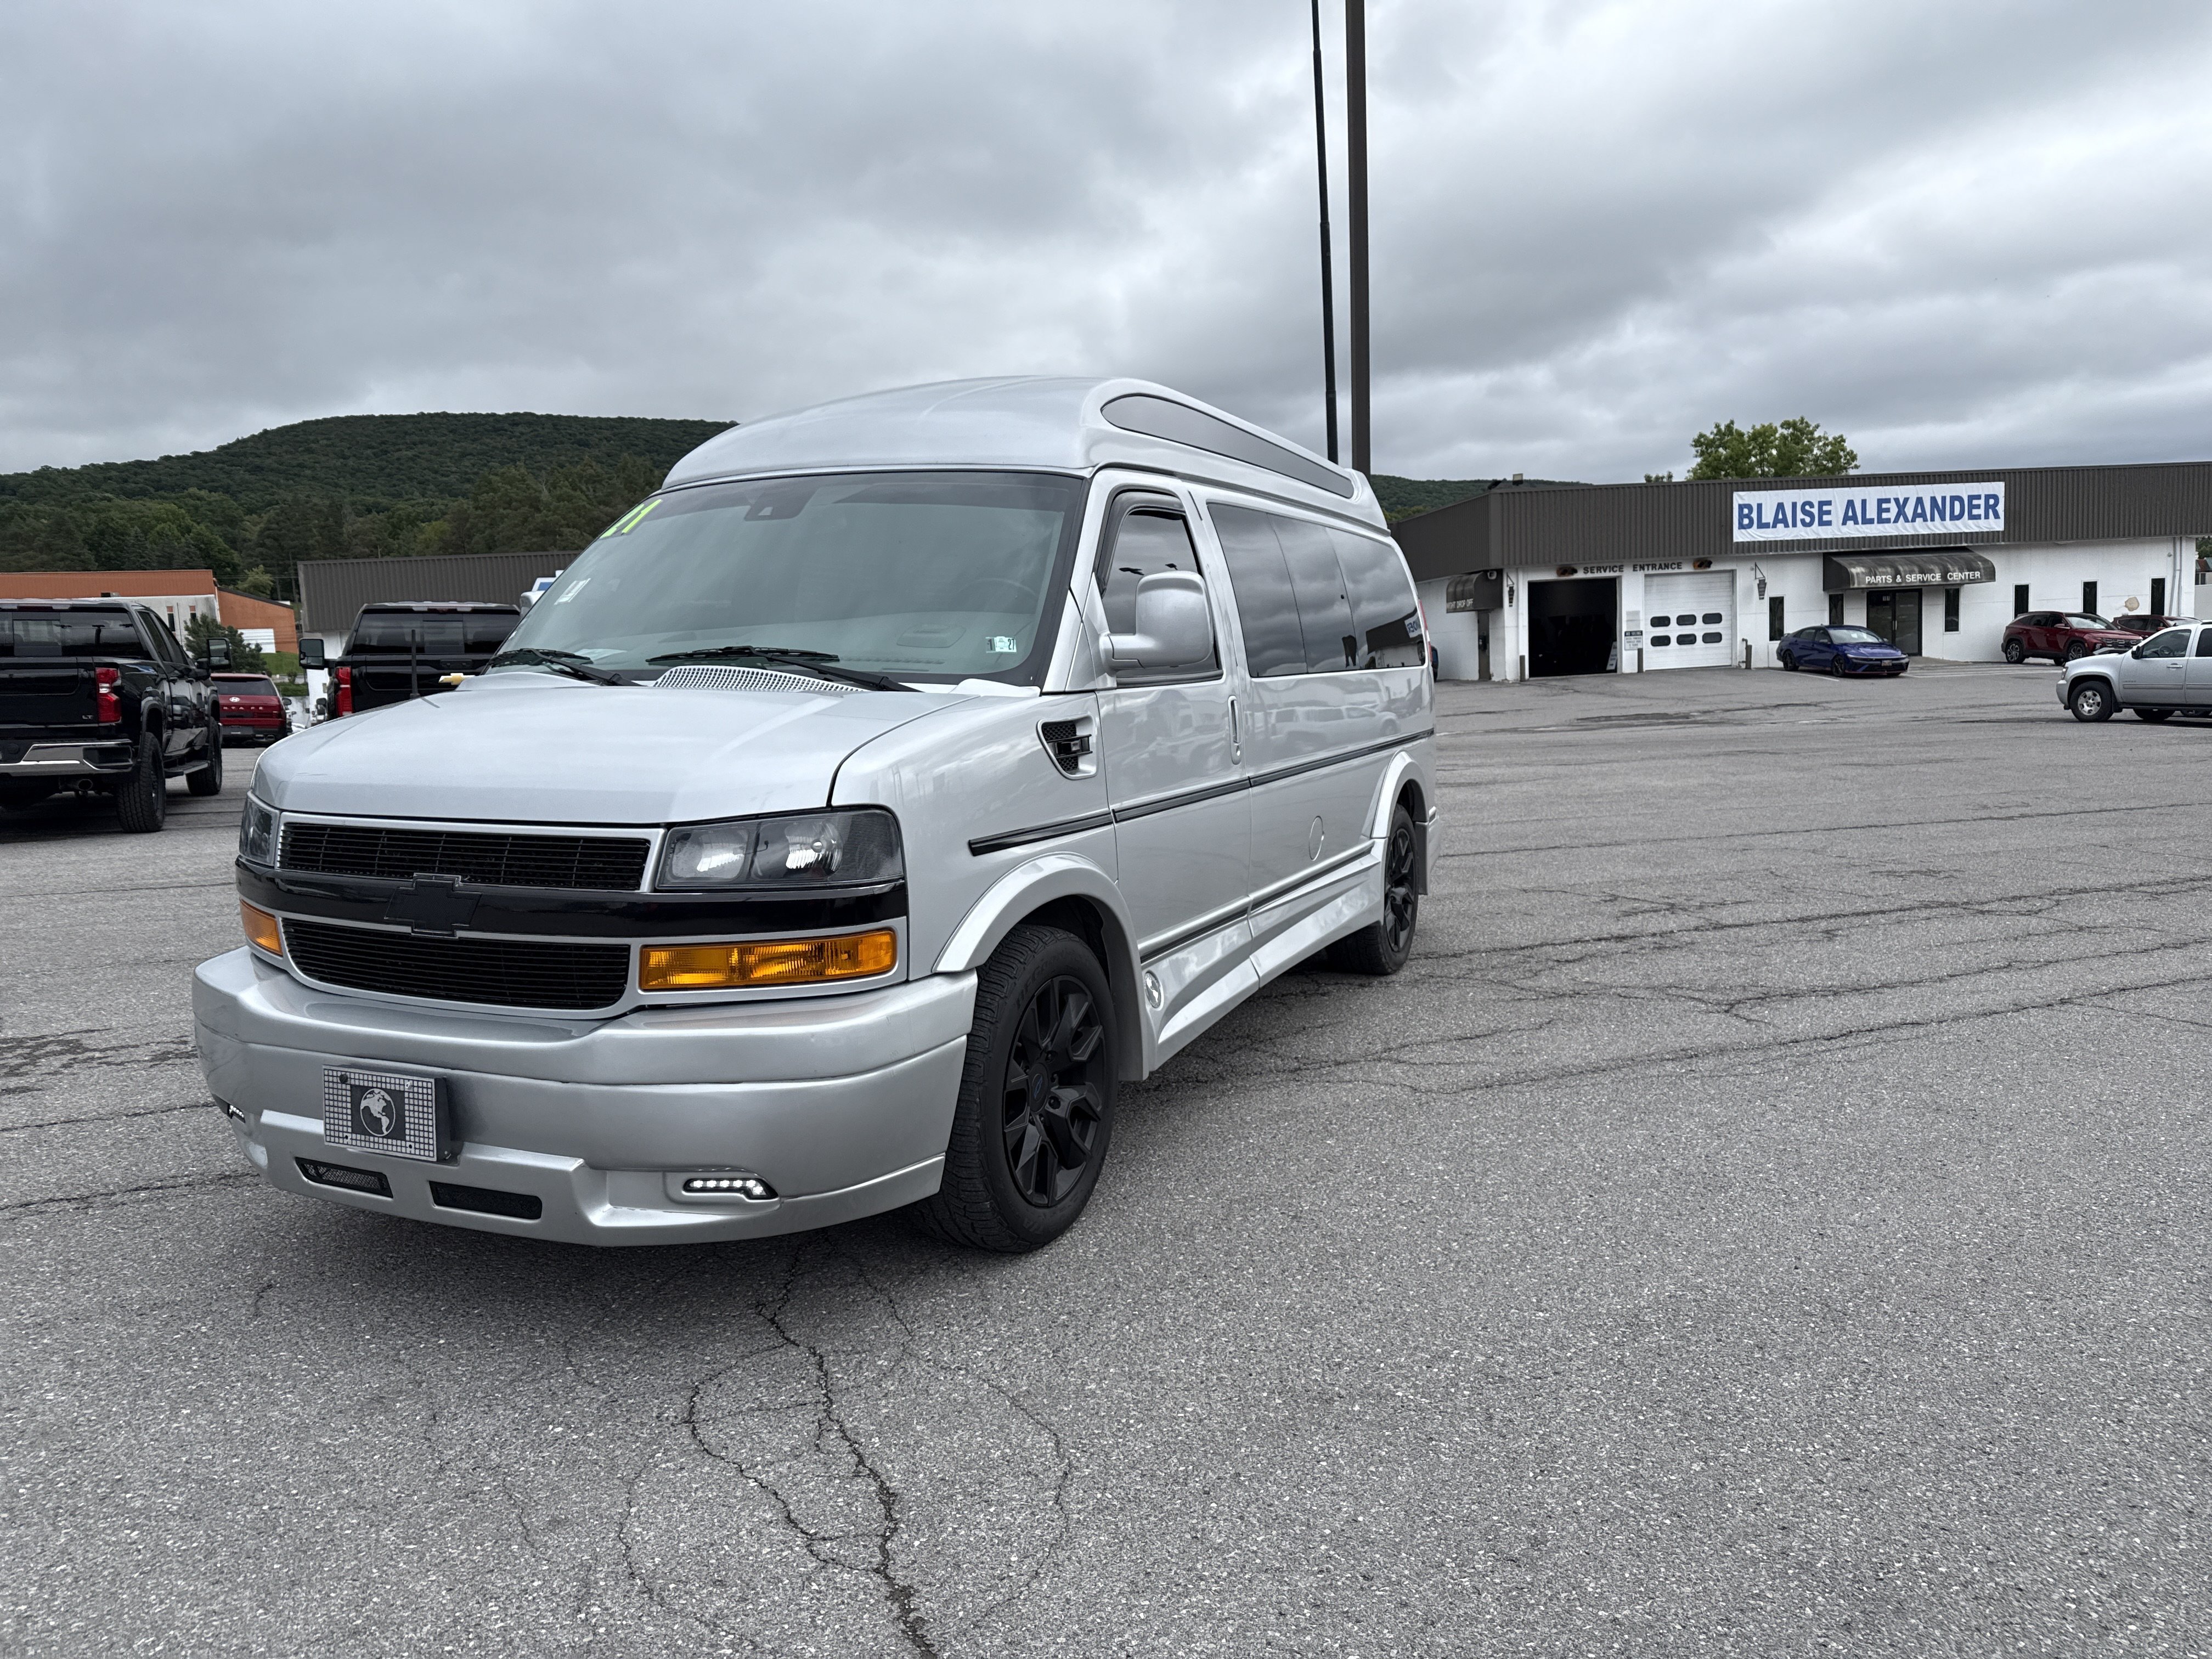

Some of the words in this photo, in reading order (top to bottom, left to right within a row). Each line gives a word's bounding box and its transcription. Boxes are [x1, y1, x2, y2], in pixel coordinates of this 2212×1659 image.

[1738, 500, 1832, 529] BLAISE
[1842, 494, 2000, 526] ALEXANDER
[1583, 565, 1624, 574] SERVICE
[1633, 562, 1683, 572] ENTRANCE
[1865, 575, 1892, 584] PARTS
[1895, 574, 1902, 583] &
[1906, 573, 1942, 582] SERVICE
[1947, 571, 1980, 580] CENTER
[1457, 600, 1466, 608] DROP
[1008, 638, 1014, 650] 27
